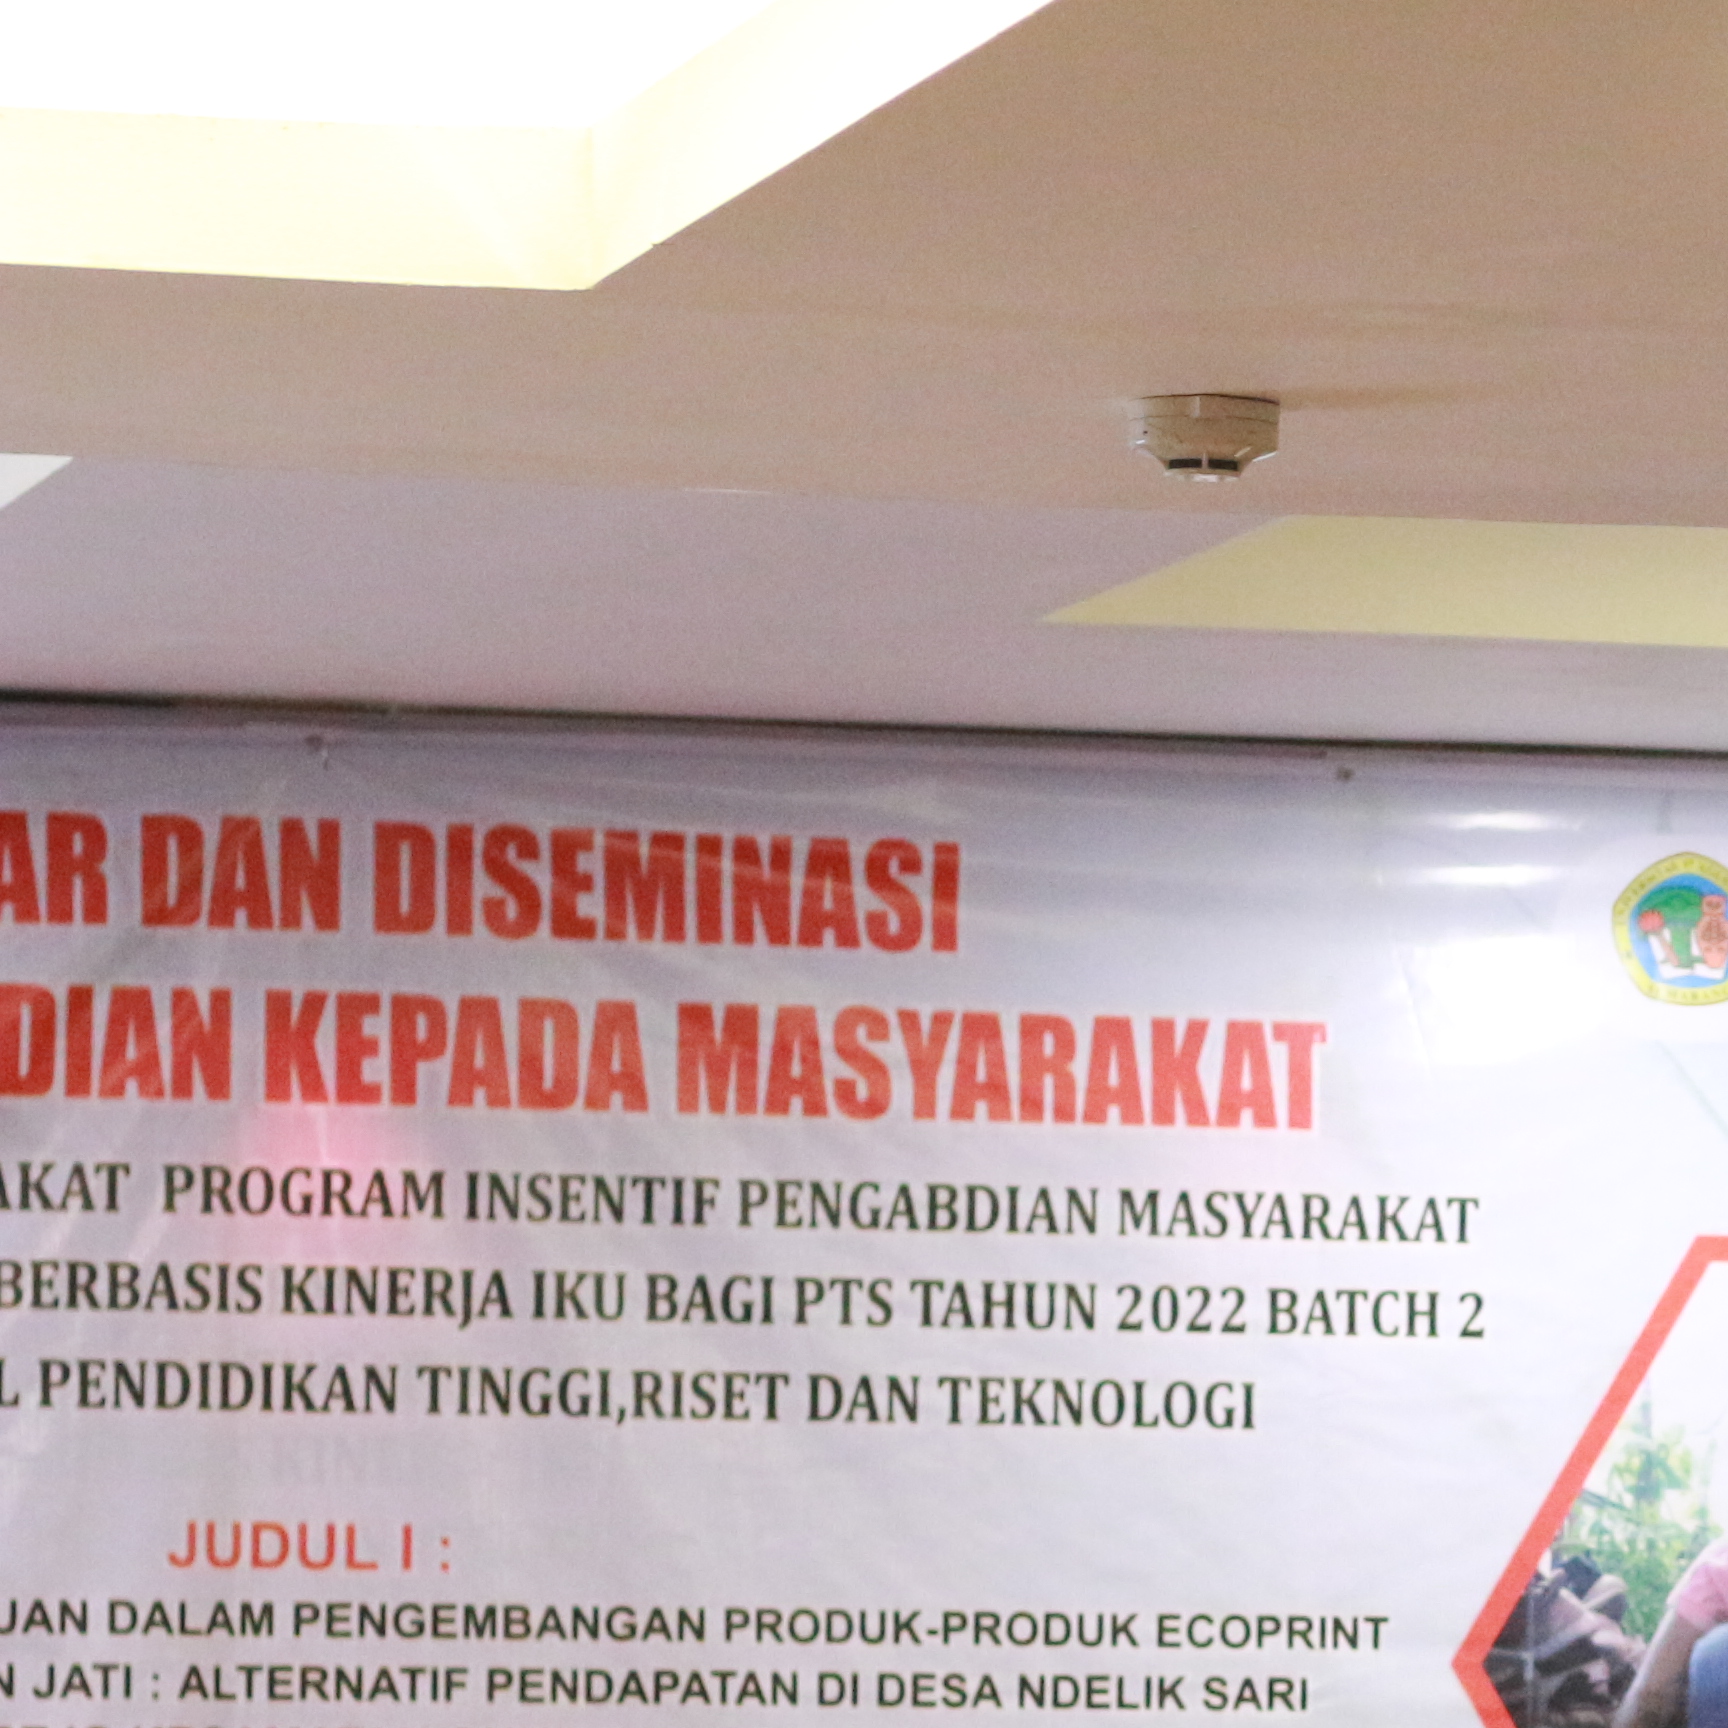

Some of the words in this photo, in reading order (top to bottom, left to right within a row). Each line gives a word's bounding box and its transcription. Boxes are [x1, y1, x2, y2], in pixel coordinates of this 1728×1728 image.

[0, 810, 109, 925] AR
[140, 815, 342, 930] DAN
[373, 822, 961, 951] DISEMINASI
[0, 983, 233, 1101] DIAN
[263, 990, 650, 1112] KEPADA
[676, 1003, 1327, 1129] MASYARAKAT
[162, 1163, 446, 1221] PROGRAM
[464, 1171, 721, 1226] INSENTIF
[738, 1178, 1099, 1235] PENGABDIAN
[1118, 1189, 1480, 1244] MASYARAKAT
[0, 1259, 263, 1314] BERBASIS
[281, 1265, 515, 1328] KINERJA
[531, 1269, 627, 1321] IKU
[645, 1273, 775, 1325] BAGI
[793, 1276, 894, 1327] PTS
[908, 1278, 1097, 1331] TAHUN
[1116, 1284, 1247, 1335] 2022
[1266, 1288, 1440, 1338] BATCH
[1458, 1292, 1485, 1339] 2
[37, 1359, 399, 1414] PENDIDIKAN
[806, 1373, 921, 1424] DAN
[936, 1375, 1255, 1431] TEKNOLOGI
[168, 1521, 379, 1571] JUDUL
[401, 1524, 414, 1571] I
[106, 1599, 276, 1638] DALAM
[292, 1601, 707, 1643] PENGEMBANGAN
[723, 1607, 1140, 1649] PRODUK-PRODUK
[1155, 1611, 1390, 1651] ECOPRINT
[32, 1662, 133, 1700] JATI
[177, 1663, 470, 1703] ALTERNATIF
[485, 1667, 800, 1706] PENDAPATAN
[816, 1671, 860, 1707] DI
[875, 1671, 1004, 1709] DESA
[1017, 1673, 1186, 1711] NDELIK
[1202, 1675, 1309, 1712] SARI
